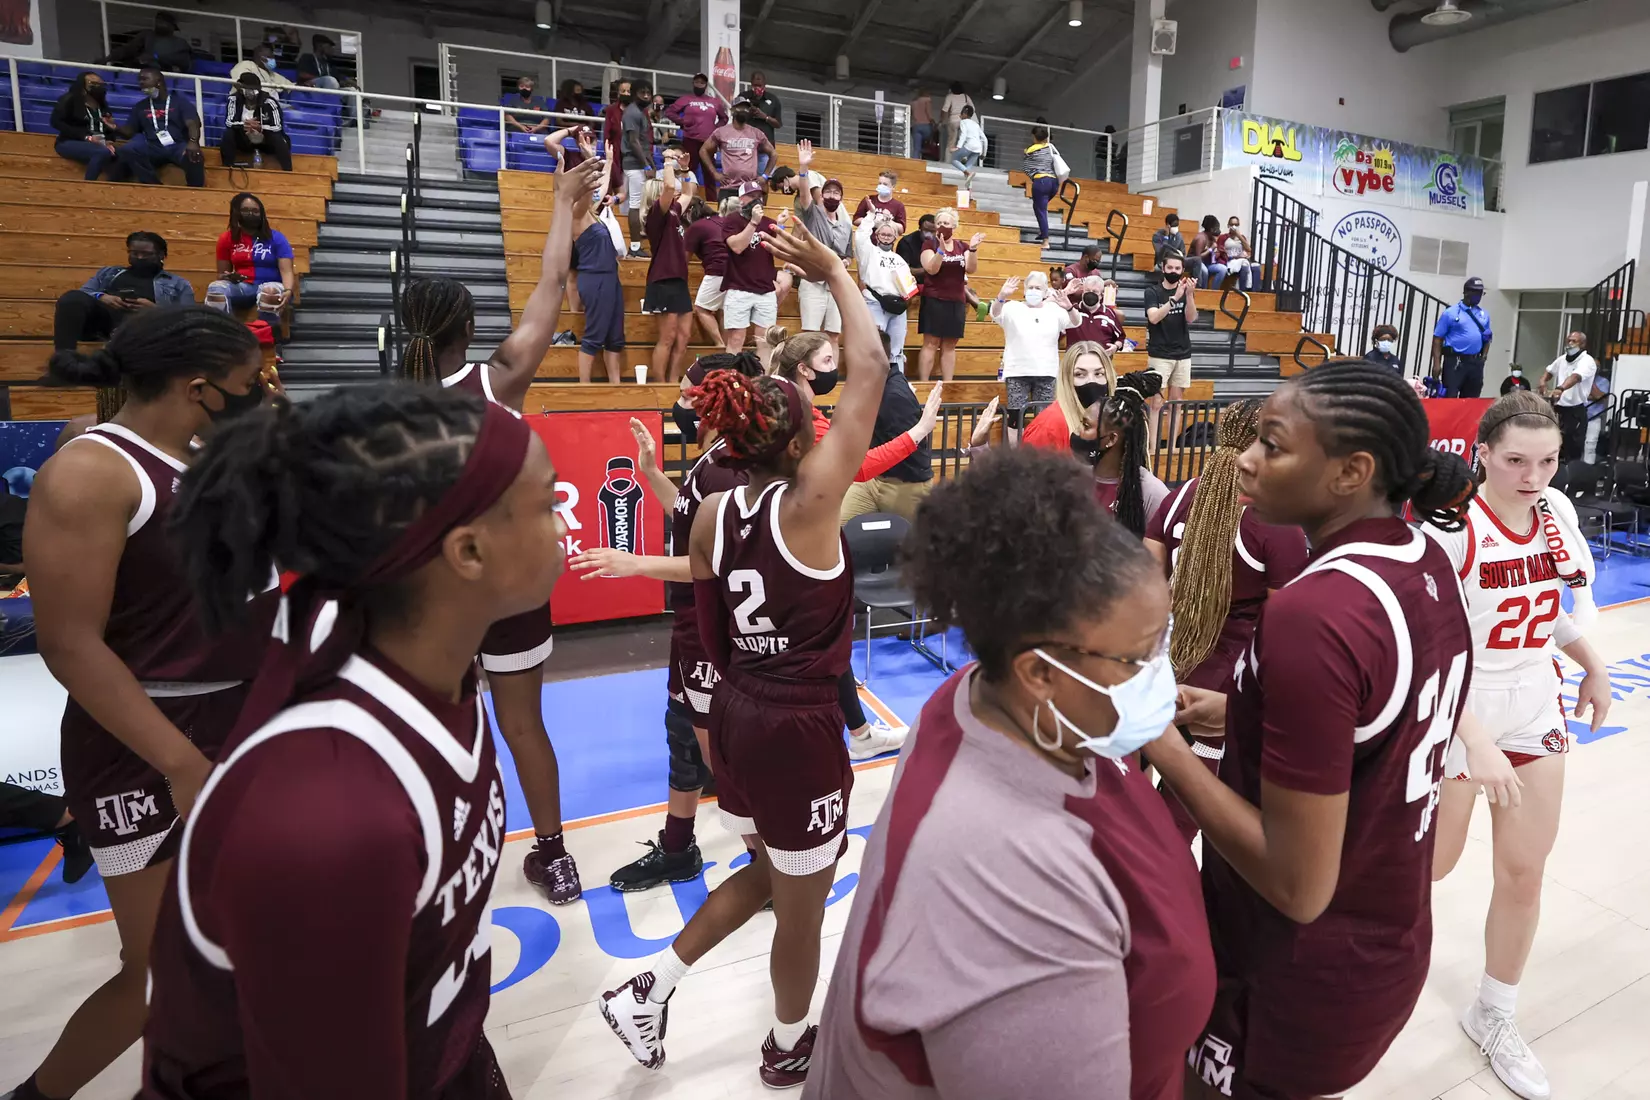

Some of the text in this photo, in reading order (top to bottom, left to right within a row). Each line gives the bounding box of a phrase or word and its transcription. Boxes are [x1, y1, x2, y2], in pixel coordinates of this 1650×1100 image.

[1242, 119, 1302, 161] DIAL
[1428, 190, 1467, 210] MUSSELS
[1337, 216, 1398, 244] NO PASSPORT
[1480, 556, 1526, 590] SOUTH
[727, 568, 779, 635] 2
[1485, 588, 1560, 650] 22
[1405, 650, 1469, 804] 24
